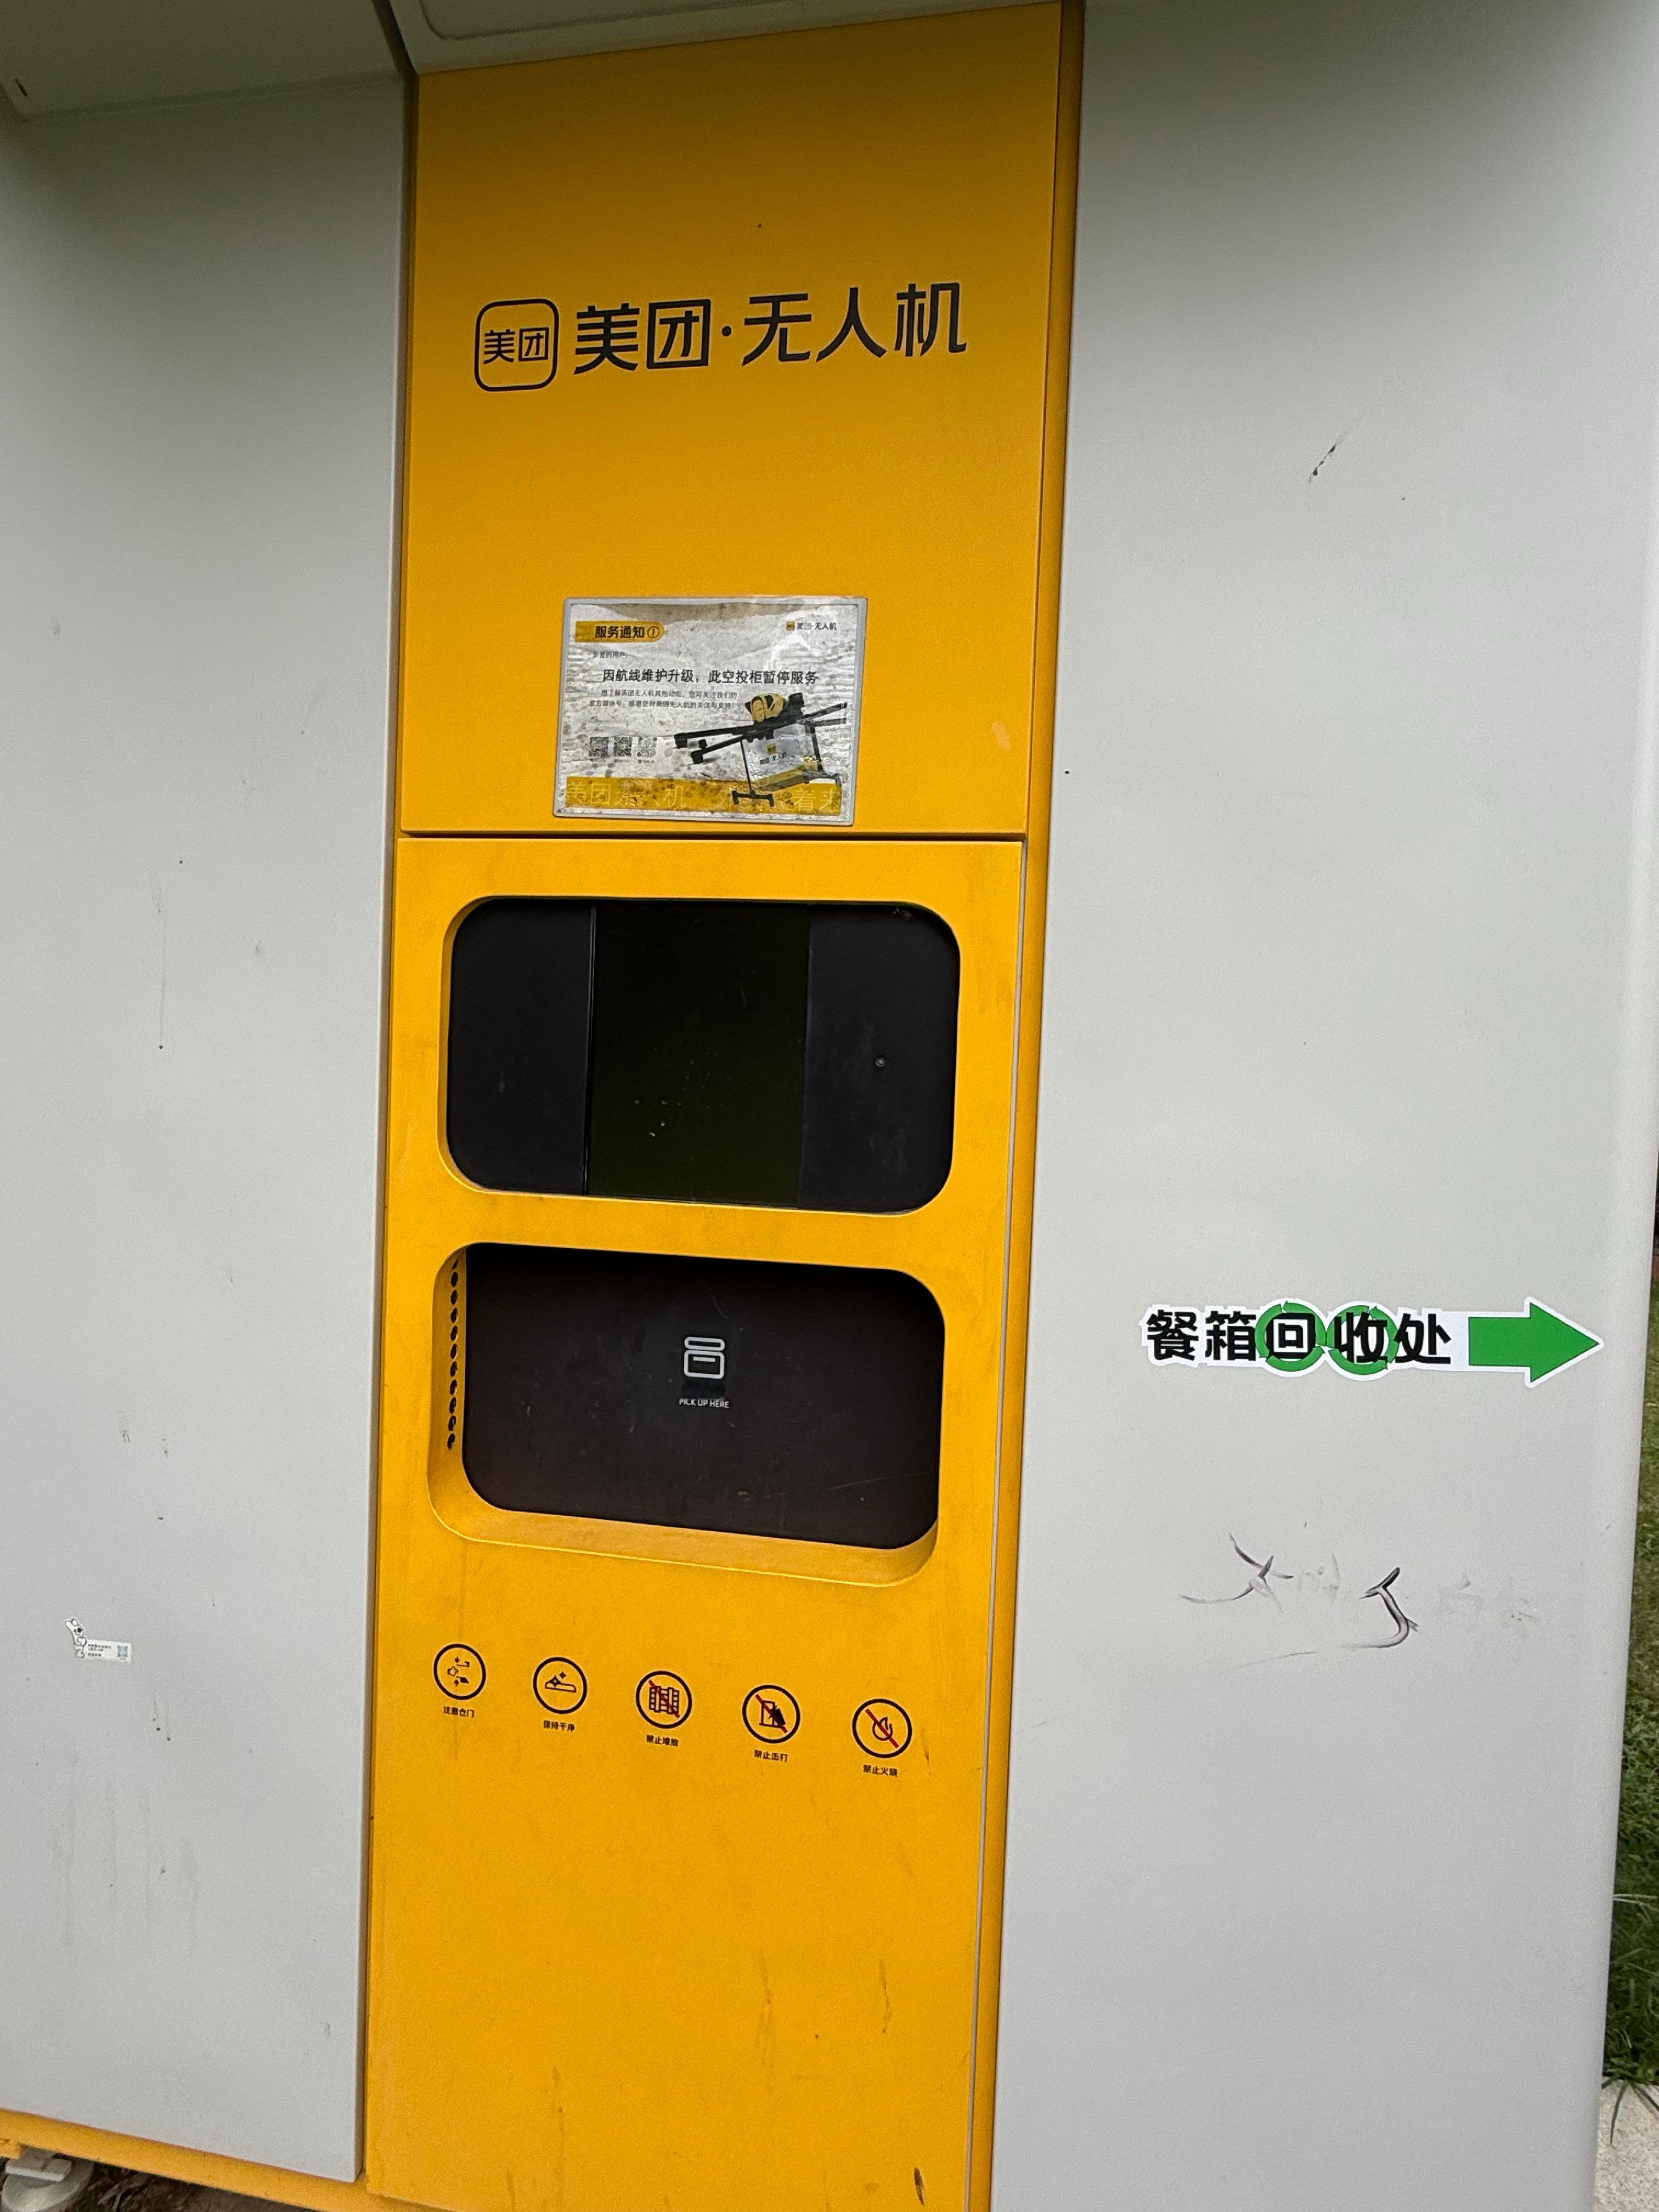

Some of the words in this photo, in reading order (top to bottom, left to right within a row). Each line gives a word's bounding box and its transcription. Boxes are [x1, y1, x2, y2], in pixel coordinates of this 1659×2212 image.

[574, 282, 967, 375] 美团·无人机
[484, 328, 549, 364] 美团
[602, 668, 818, 685] 因航线维护升级，此空投柜暂停服务
[1147, 1310, 1451, 1364] 餐箱回收处
[709, 1400, 730, 1409] HERE
[443, 1706, 475, 1718] 注意仓门
[543, 1720, 575, 1733] 保持干净
[646, 1734, 679, 1747] 禁止堆放
[754, 1750, 788, 1763] 禁止击打
[863, 1764, 898, 1778] 禁止火烧
